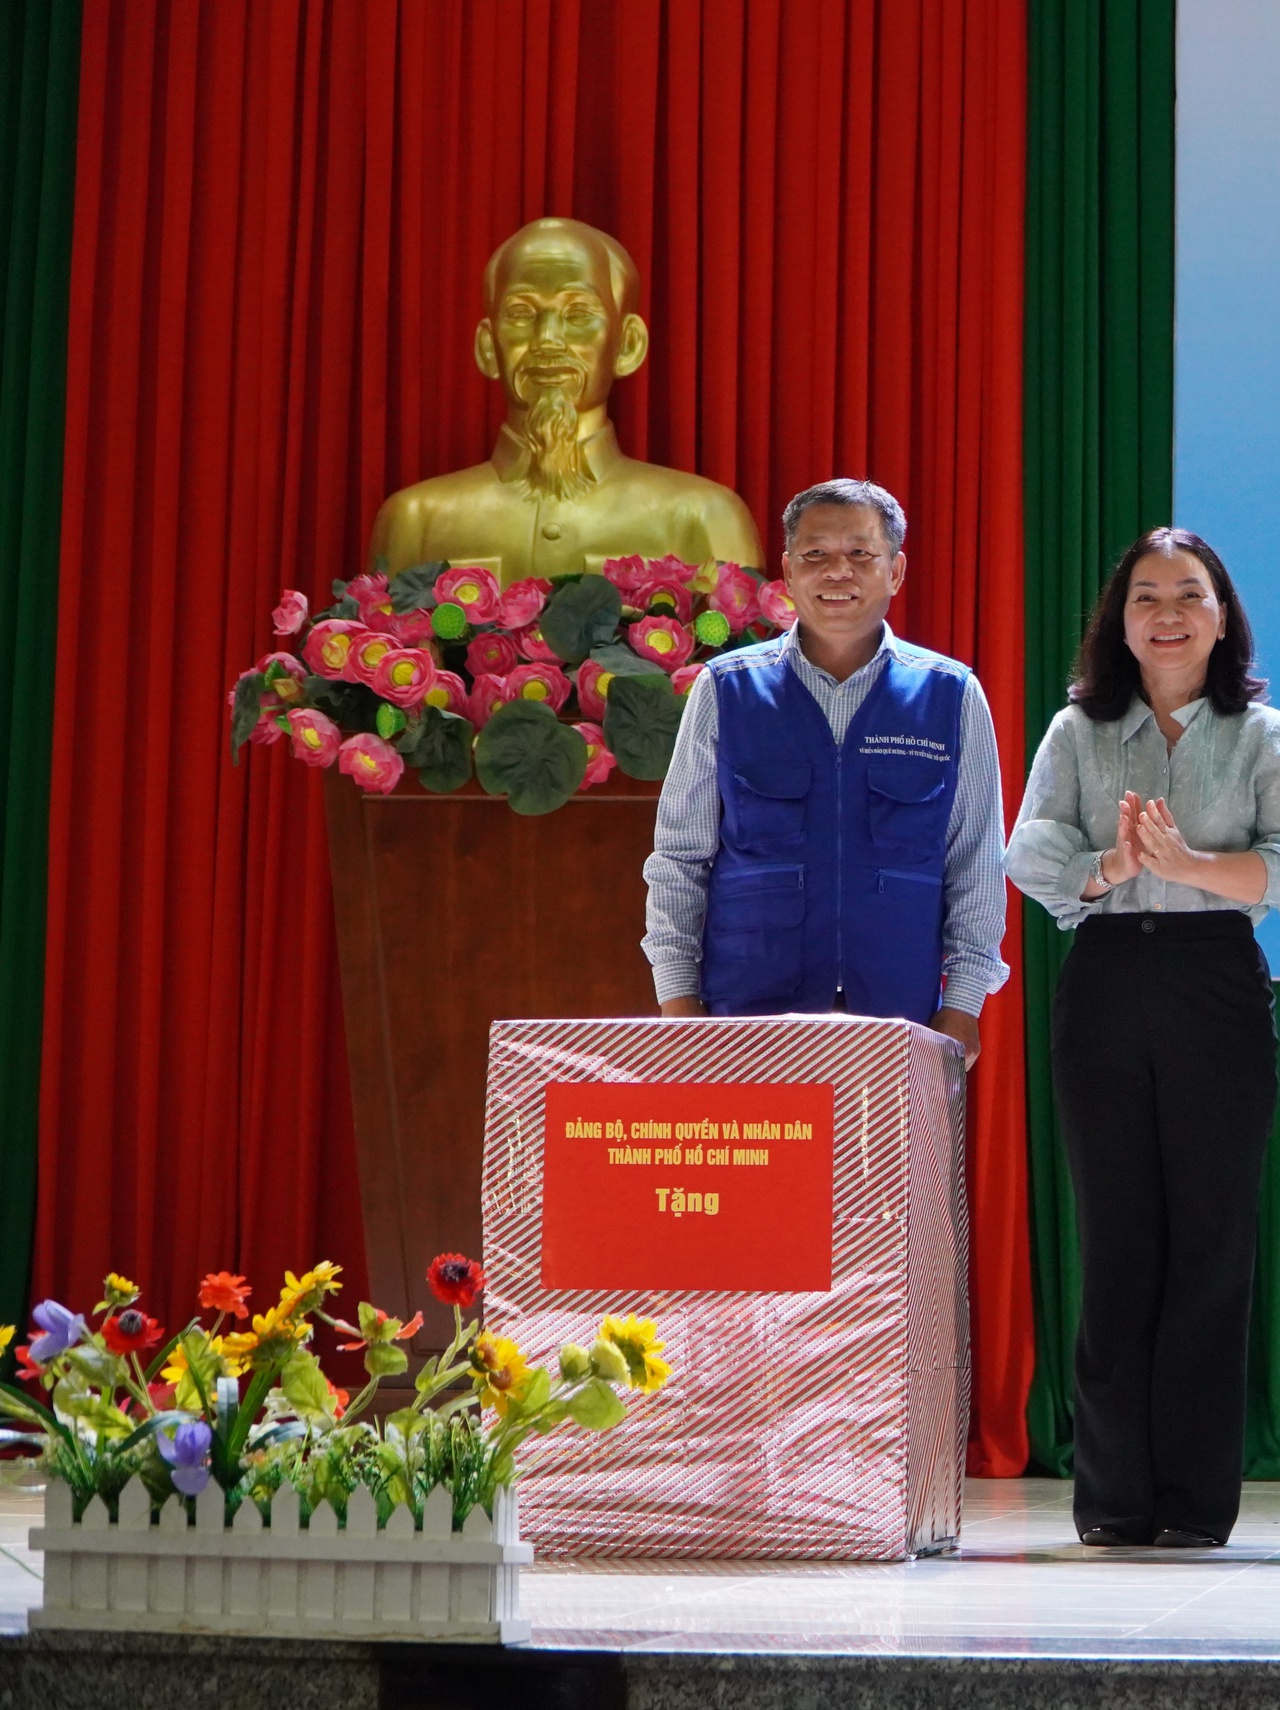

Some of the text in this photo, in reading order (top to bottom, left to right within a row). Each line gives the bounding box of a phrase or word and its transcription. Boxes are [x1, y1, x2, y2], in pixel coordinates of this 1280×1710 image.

[928, 740, 945, 751] MINH
[565, 1116, 813, 1142] ĐẢNG BỘ, CHÍNH QUYỀN VÀ NHÂN DÂN
[608, 1143, 769, 1166] THÀNH PHỐ HỒ CHÍ MINH
[655, 1187, 720, 1218] Tặng
